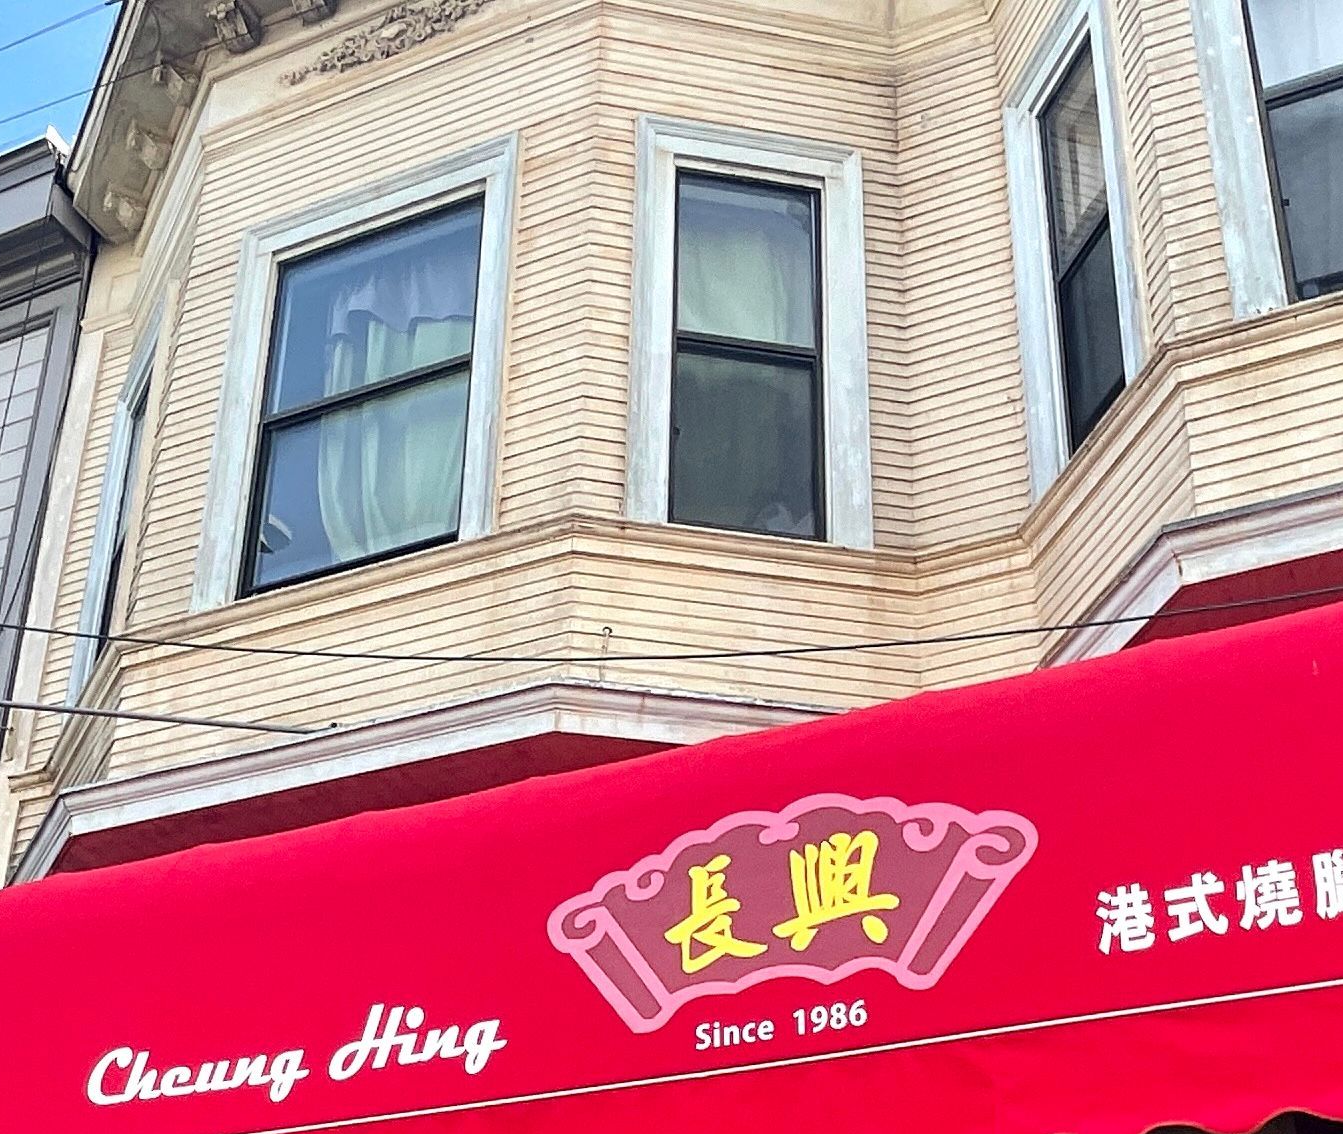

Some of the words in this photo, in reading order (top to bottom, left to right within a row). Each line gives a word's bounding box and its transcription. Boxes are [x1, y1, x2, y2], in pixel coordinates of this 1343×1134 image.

[662, 830, 900, 974] 長興
[87, 1046, 311, 1106] Cheung
[328, 1003, 508, 1081] Hing
[695, 1020, 775, 1051] Since
[792, 998, 868, 1036] 1986
